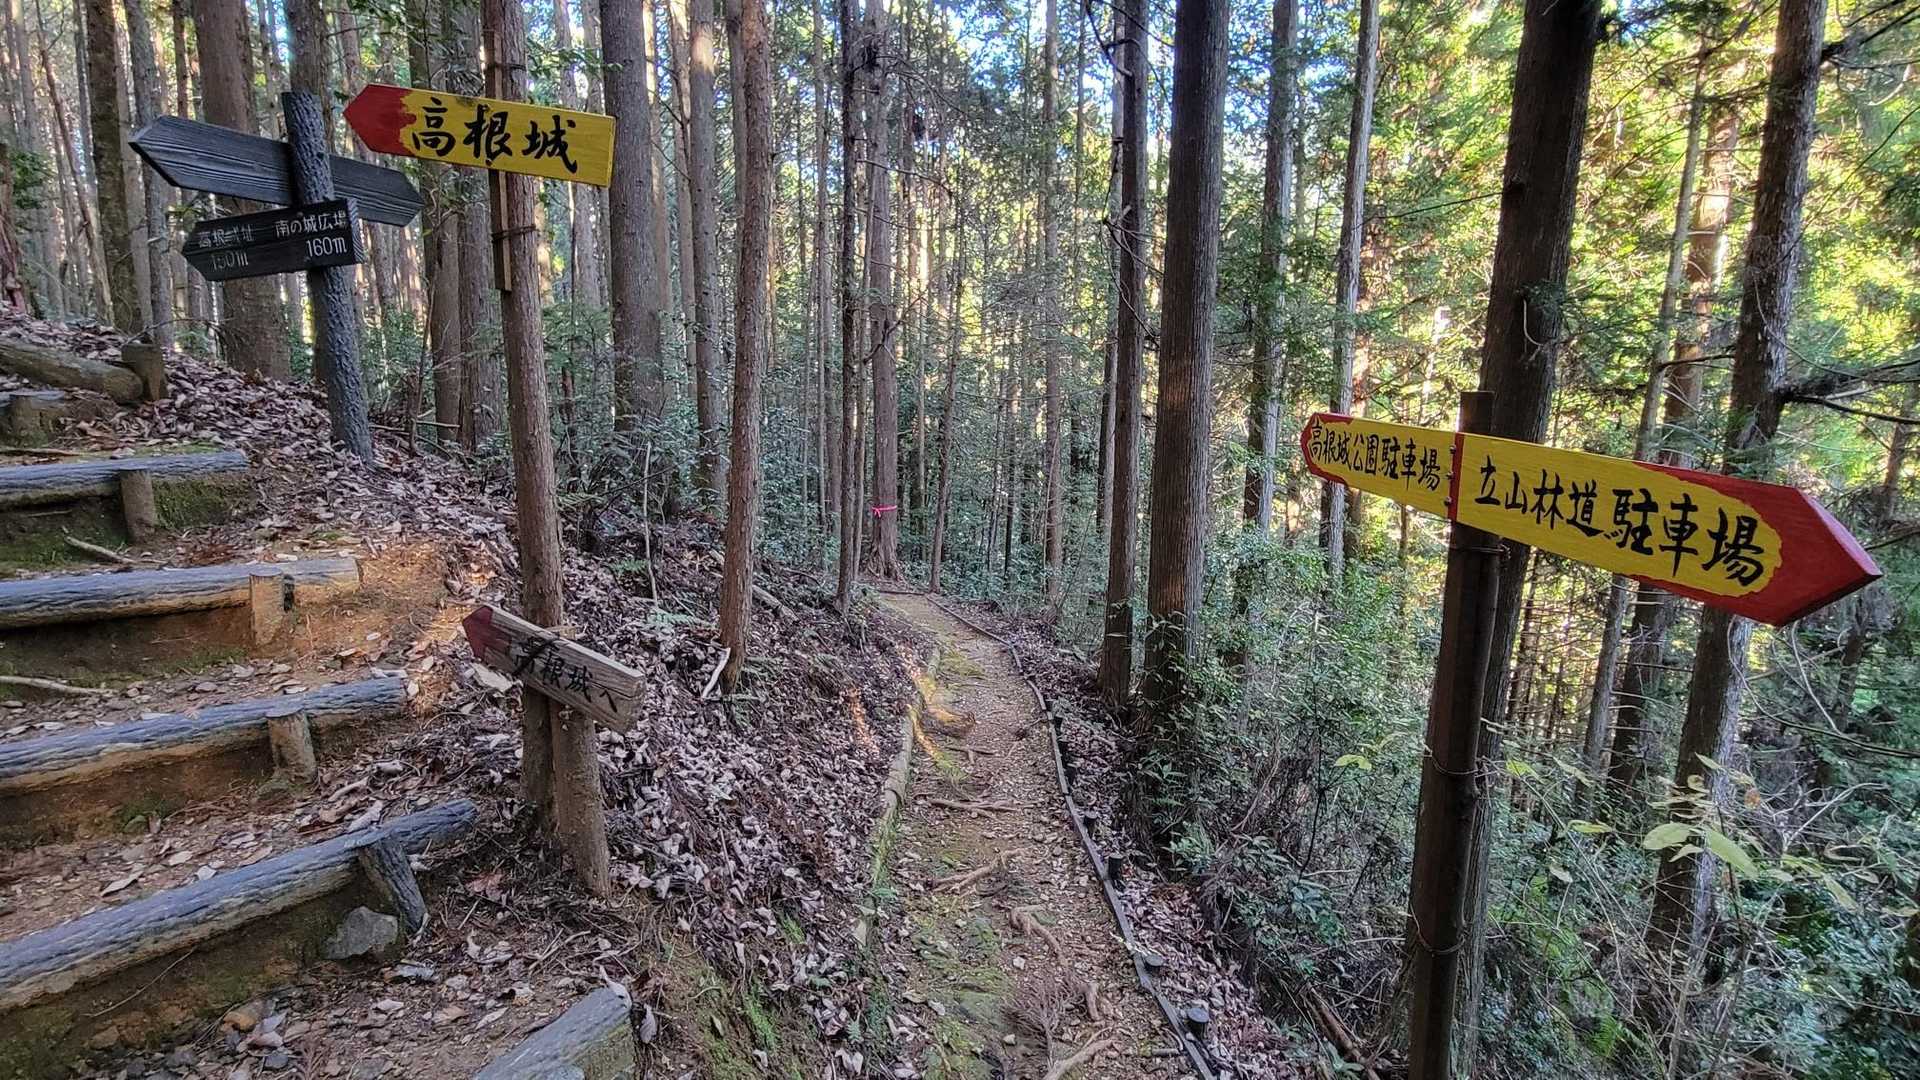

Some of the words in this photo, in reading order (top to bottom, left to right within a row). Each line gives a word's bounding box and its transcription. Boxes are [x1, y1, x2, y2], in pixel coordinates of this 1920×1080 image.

[412, 97, 578, 172] 高根城
[275, 211, 347, 238] 南の城広場
[306, 236, 348, 257] 160m
[1310, 417, 1442, 491] 高根城公園駐車場
[1475, 455, 1765, 586] 立山林道駐車場
